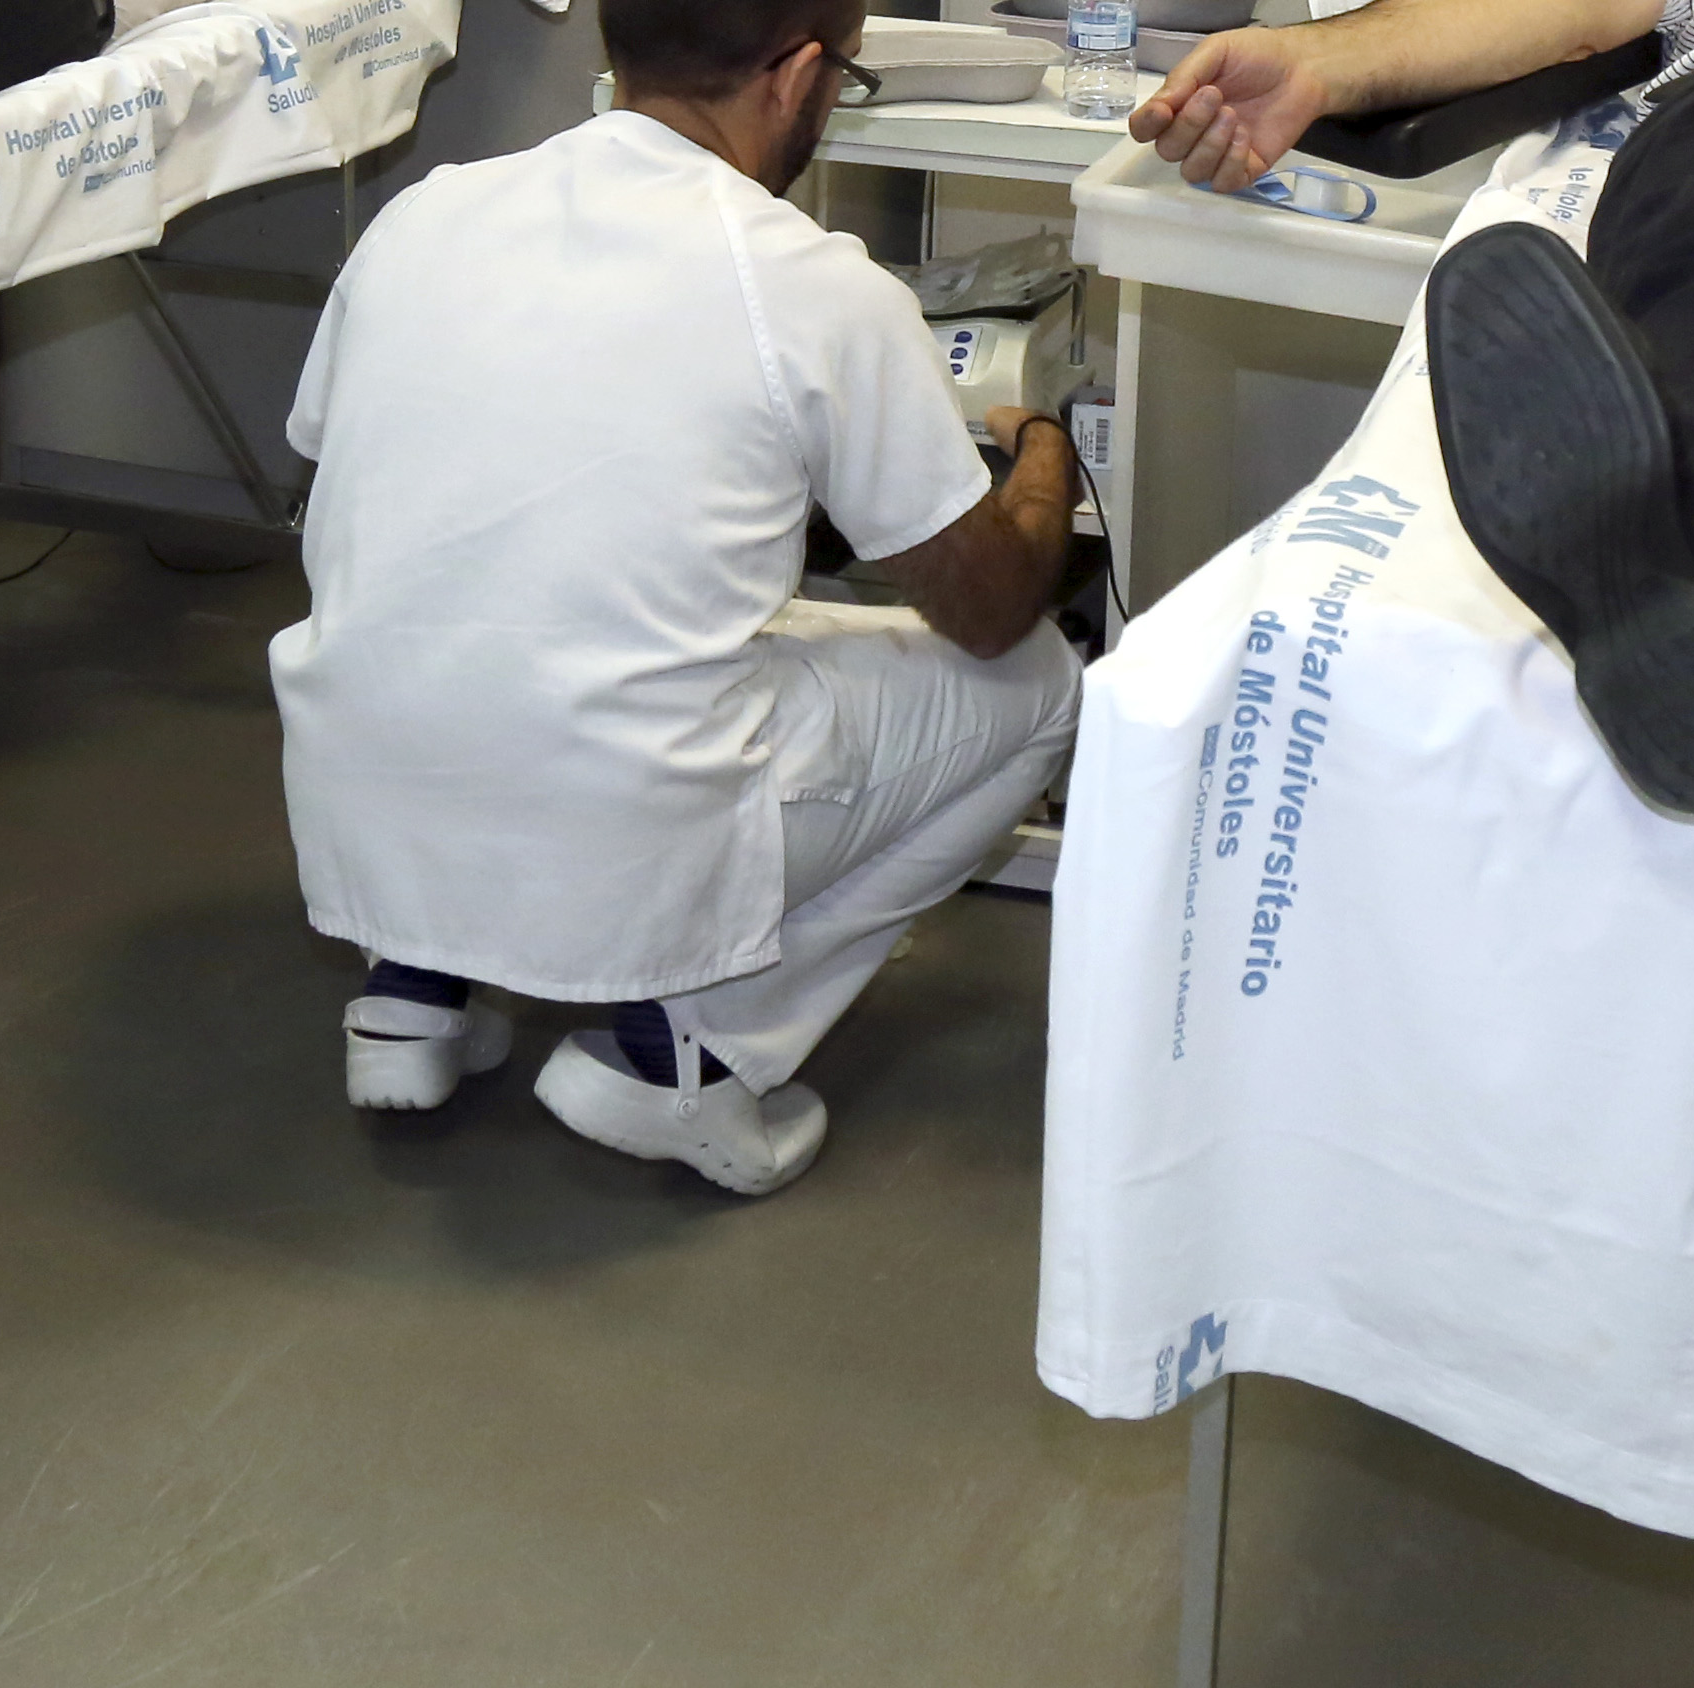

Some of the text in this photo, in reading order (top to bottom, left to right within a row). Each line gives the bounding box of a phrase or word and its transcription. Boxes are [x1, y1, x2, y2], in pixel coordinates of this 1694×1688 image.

[306, 8, 354, 47] Hospital
[5, 114, 81, 155] Hospital
[57, 154, 75, 178] de
[1247, 610, 1286, 654] de
[1216, 669, 1276, 859] Móstoles
[1241, 564, 1375, 998] Hospital Universitario
[1172, 769, 1214, 1061] Comunidad de Madrid
